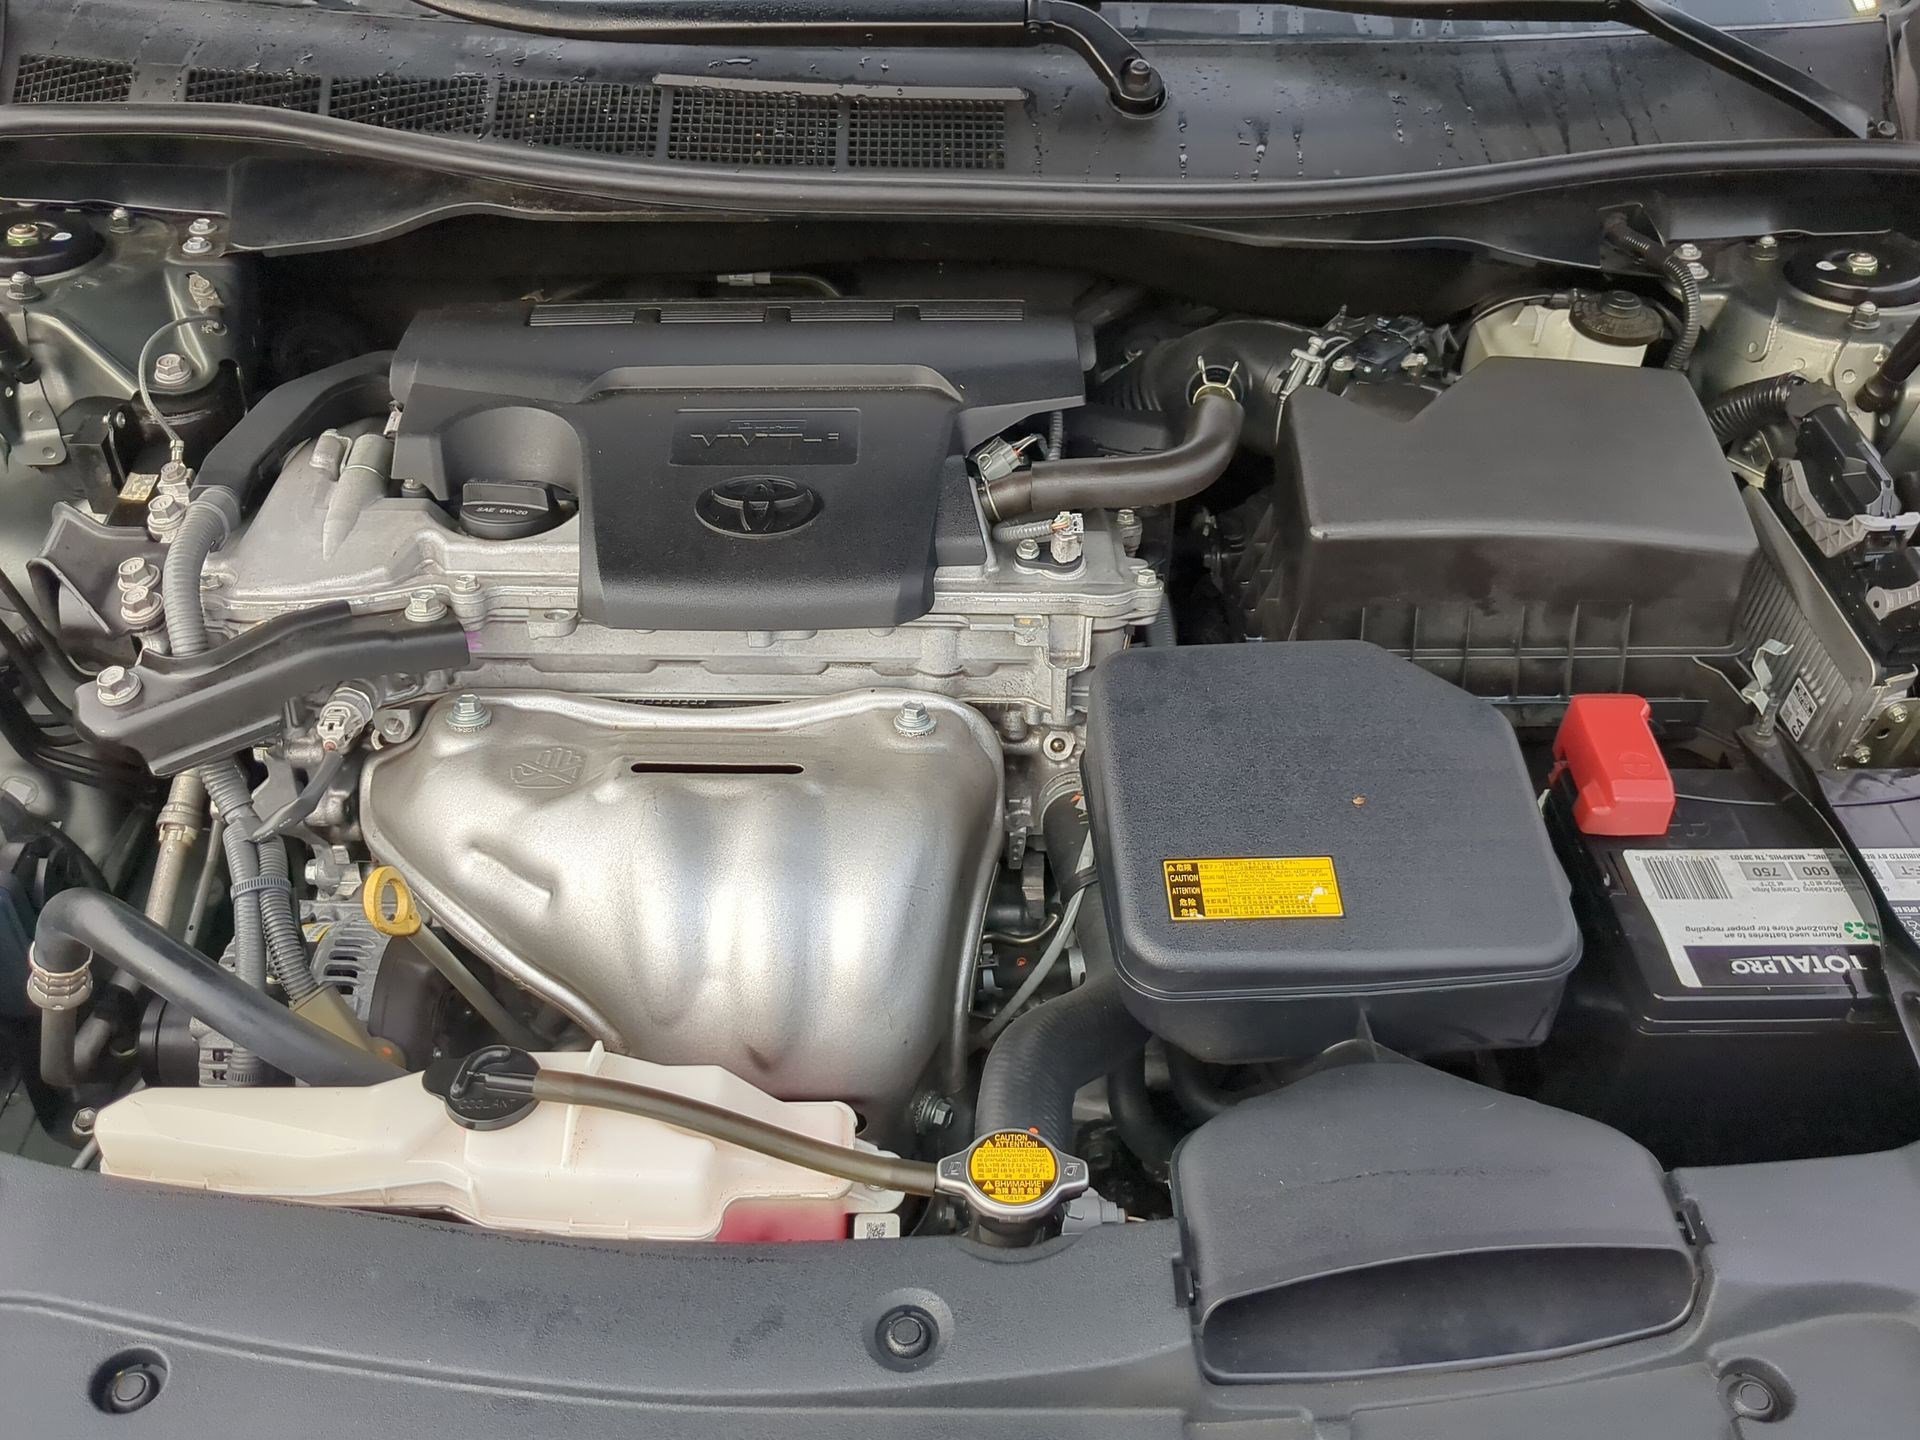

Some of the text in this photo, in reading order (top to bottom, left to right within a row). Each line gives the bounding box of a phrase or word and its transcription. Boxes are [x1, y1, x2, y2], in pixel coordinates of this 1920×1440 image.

[499, 508, 529, 516] 0W-20
[1753, 867, 1781, 877] 750
[1803, 866, 1830, 876] 600
[1169, 874, 1199, 882] CAUTION
[1172, 886, 1201, 895] ATTENTION
[1685, 925, 1724, 933] recycling
[1747, 932, 1787, 940] batteries
[1730, 954, 1868, 974] TOTALPRO
[994, 1140, 1038, 1148] ATTENTION
[994, 1180, 1044, 1188] ВНИМАНИЕ!
